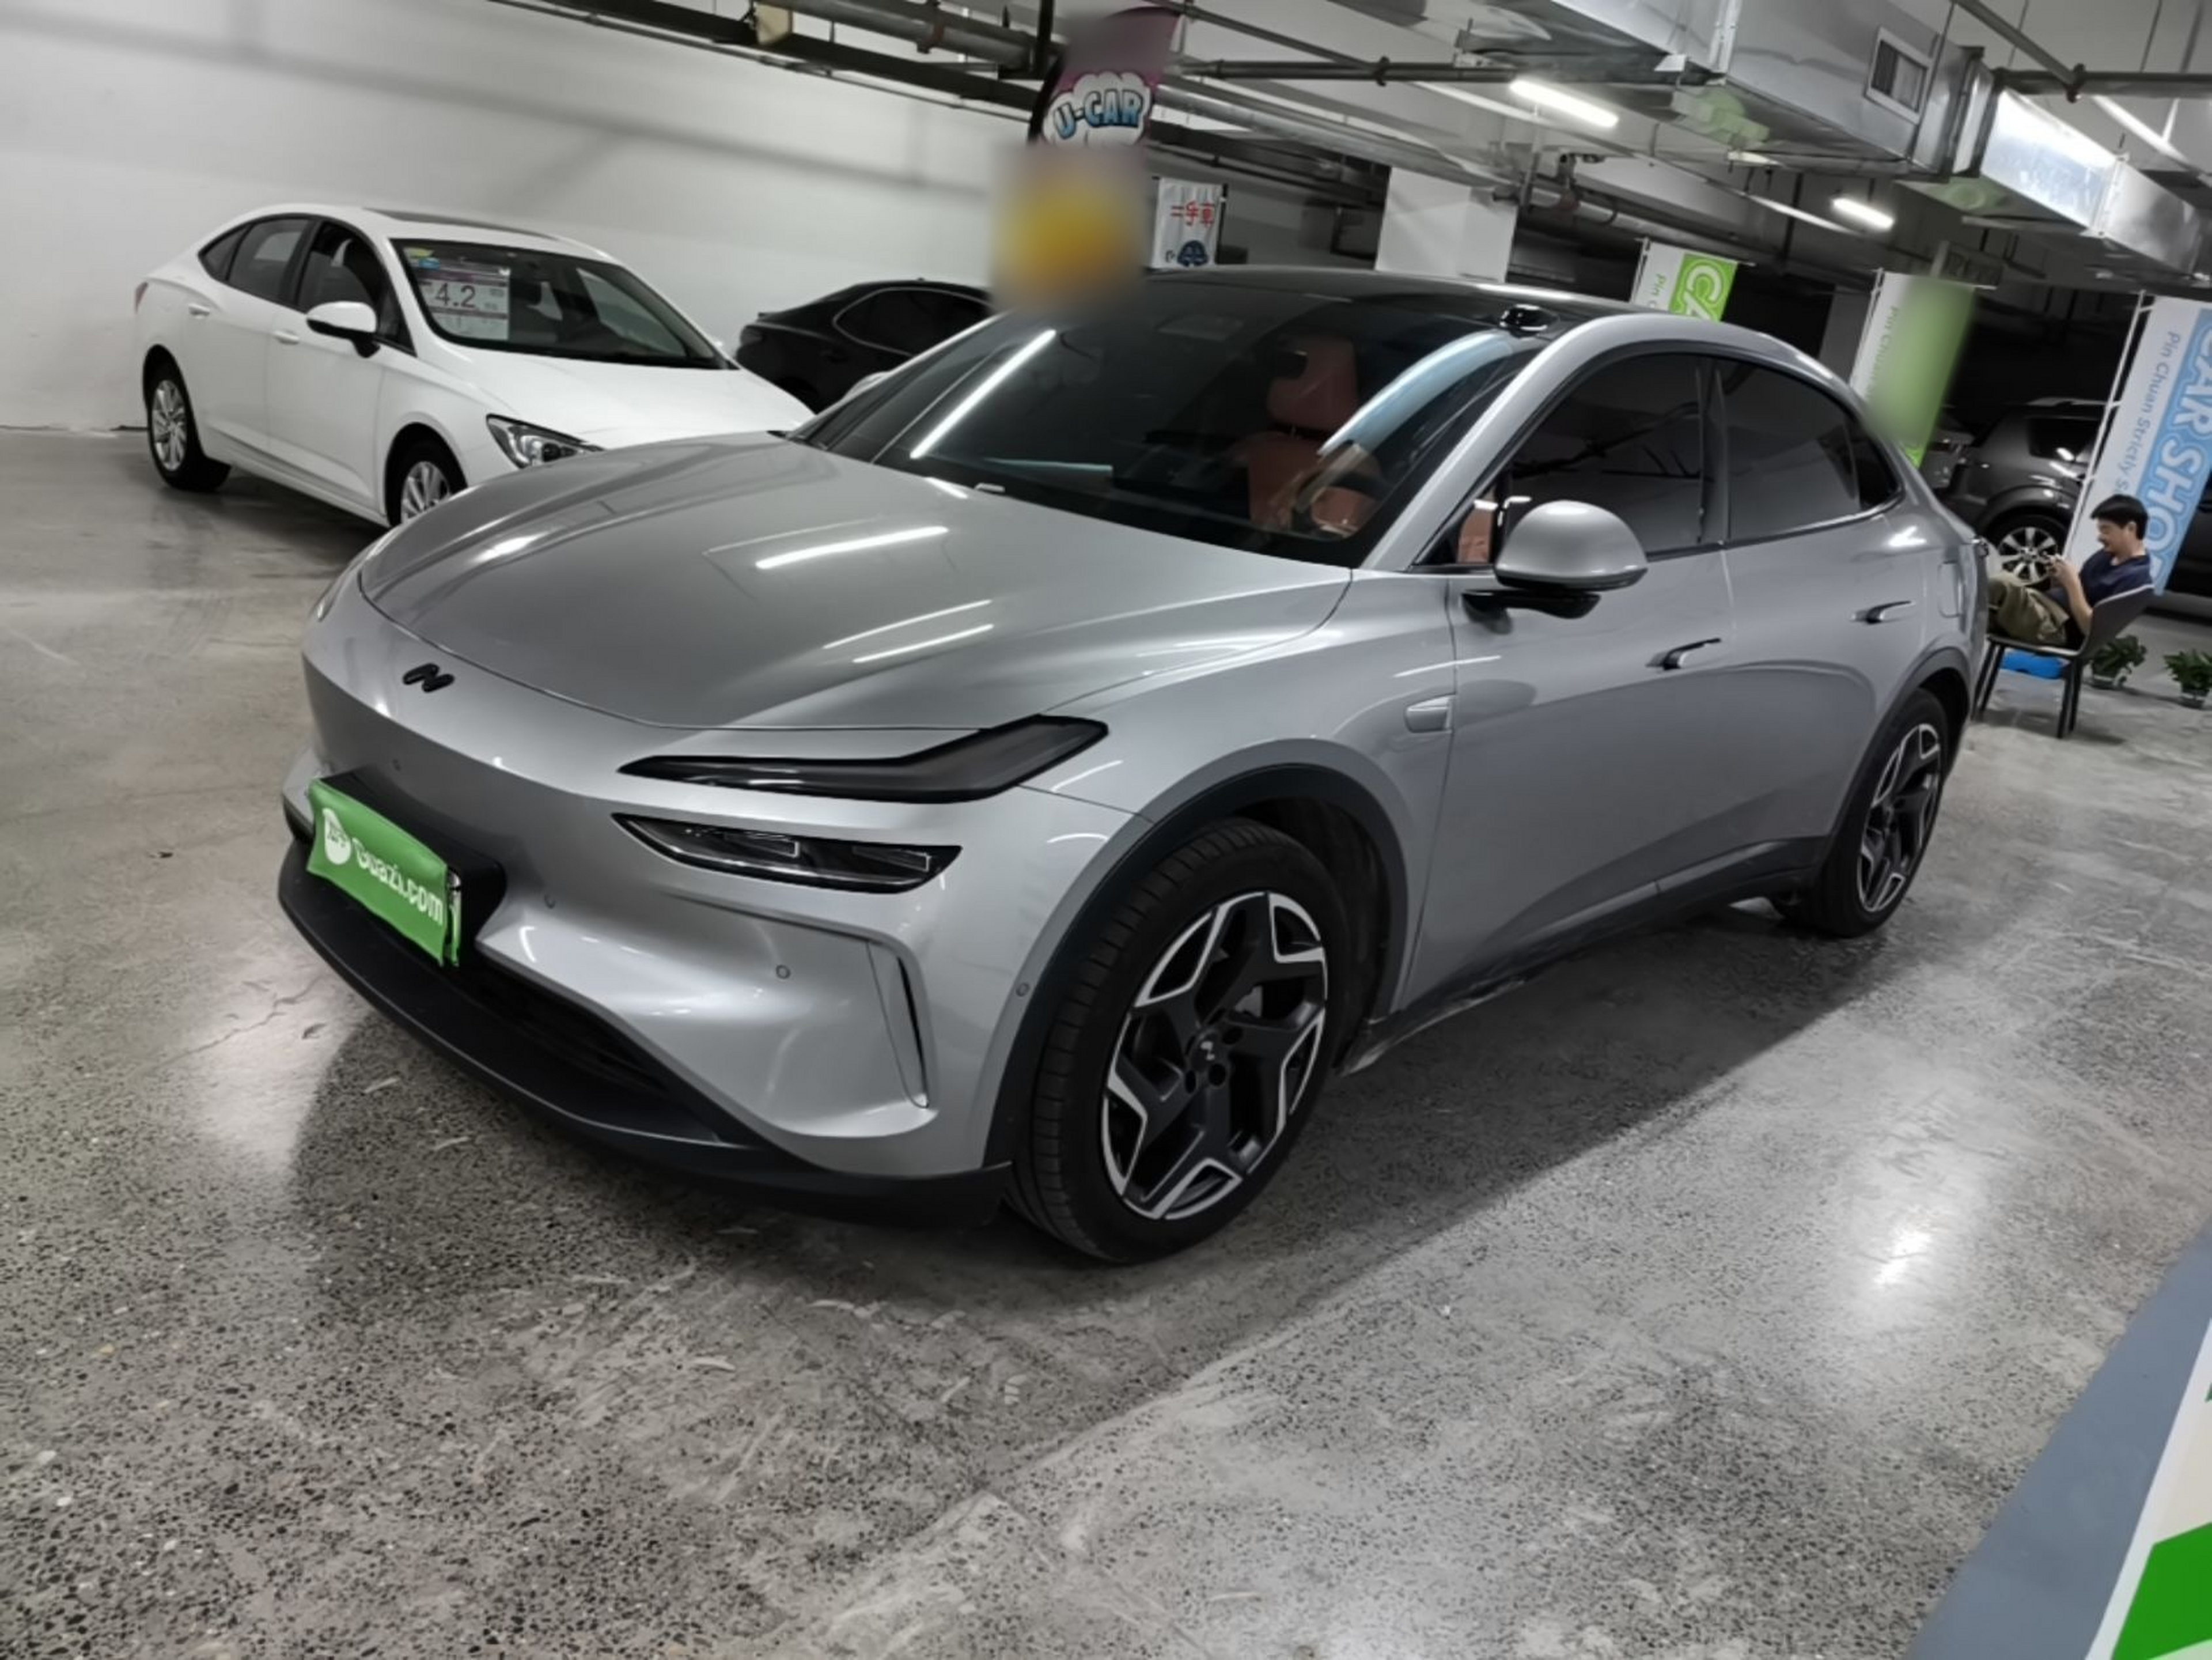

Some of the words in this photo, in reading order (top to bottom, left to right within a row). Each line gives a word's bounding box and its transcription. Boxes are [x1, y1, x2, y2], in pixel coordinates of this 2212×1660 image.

[1054, 89, 1143, 139] U-CAR
[434, 282, 476, 309] 4.2
[2160, 331, 2180, 357] Pin
[2141, 362, 2170, 413] Chuan
[2118, 417, 2151, 476] Strictly
